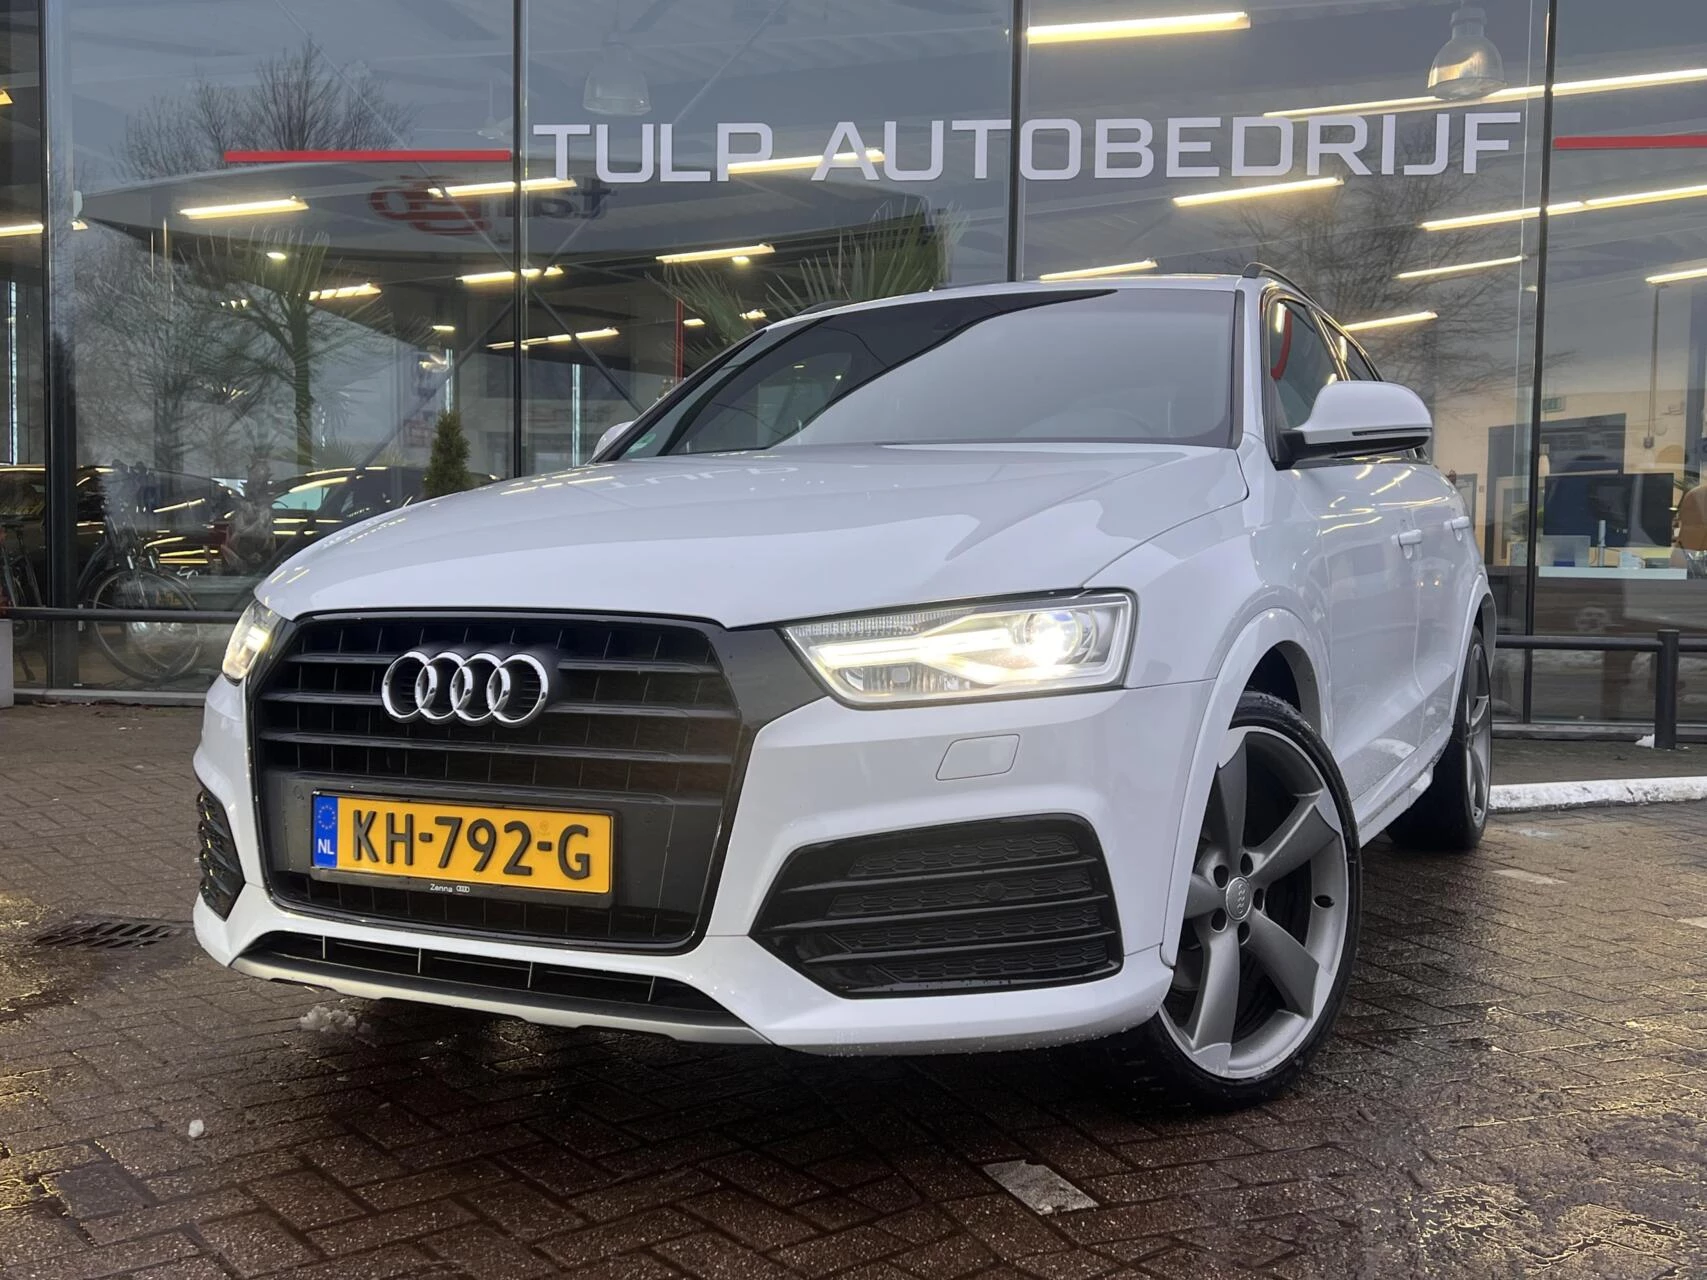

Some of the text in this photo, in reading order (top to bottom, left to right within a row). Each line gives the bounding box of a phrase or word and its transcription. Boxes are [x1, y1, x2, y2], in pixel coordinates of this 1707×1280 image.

[533, 111, 1521, 183] TULP AUTOBEDRIJF
[317, 838, 335, 855] NL
[352, 809, 591, 880] KH-792-G
